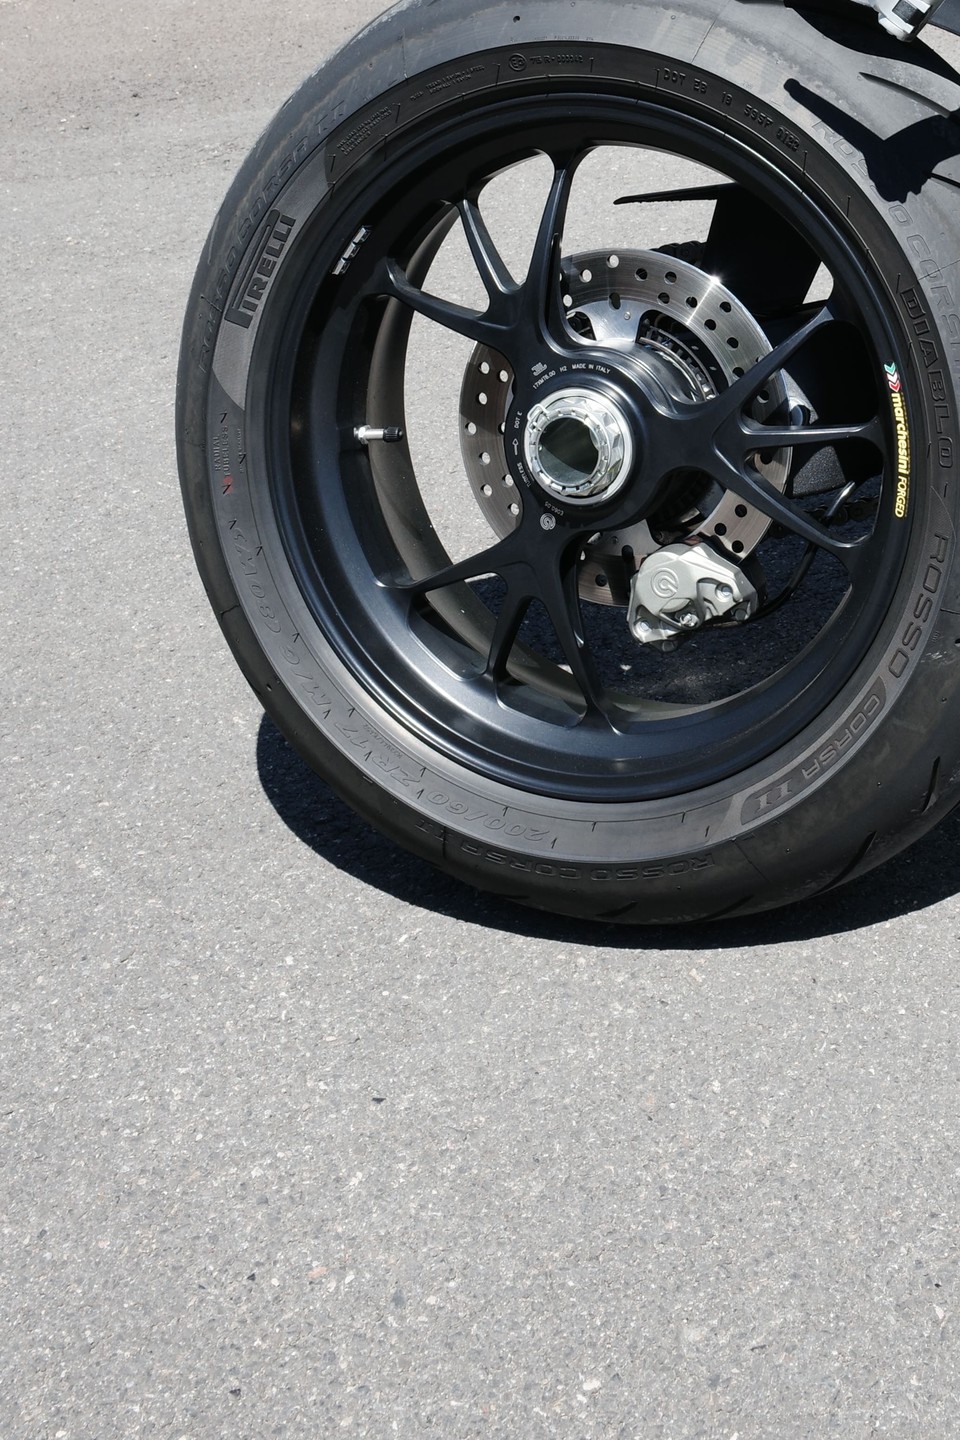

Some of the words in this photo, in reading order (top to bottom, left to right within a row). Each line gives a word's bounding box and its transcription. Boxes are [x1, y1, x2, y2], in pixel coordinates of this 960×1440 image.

[224, 207, 297, 330] PIRELLI
[595, 364, 612, 374] ITALY
[900, 286, 953, 469] DIABLO
[890, 391, 911, 475] marchesini
[894, 473, 909, 519] FORGED
[888, 532, 950, 679] ROSSO
[801, 693, 881, 780] CORSA
[426, 791, 550, 842] 200/60
[754, 778, 794, 811] II
[460, 840, 581, 880] CORSA
[589, 852, 716, 882] ROSSO
